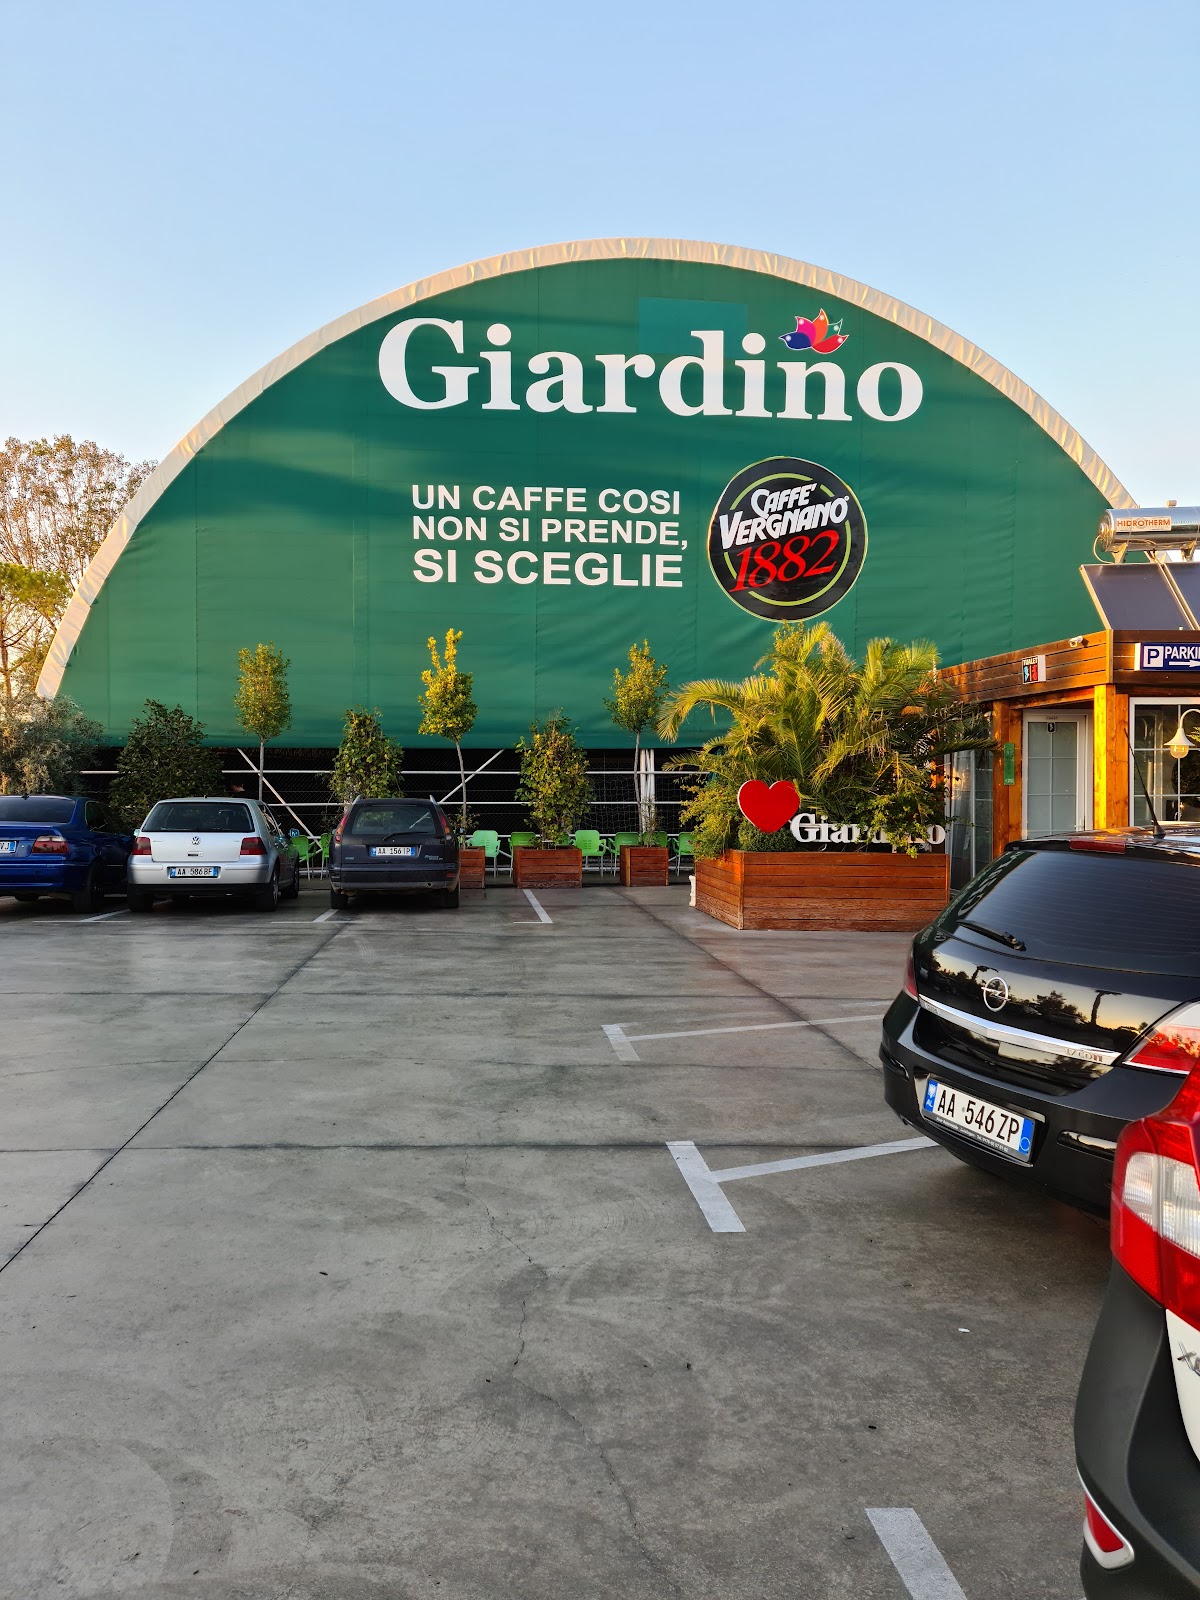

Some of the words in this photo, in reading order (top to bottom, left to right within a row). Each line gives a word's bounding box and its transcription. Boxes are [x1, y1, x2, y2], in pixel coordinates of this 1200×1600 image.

[378, 317, 924, 422] Giardino
[412, 484, 460, 510] UN
[472, 485, 587, 512] CAFFE
[598, 488, 680, 515] COSI
[412, 515, 487, 541] NON
[498, 517, 530, 542] SI
[541, 518, 688, 550] PRENDE,
[719, 496, 848, 549] VERGNANO
[1117, 519, 1170, 527] HIDROTHERM
[412, 548, 457, 583] SI
[473, 550, 683, 588] SCEGLIE
[729, 530, 839, 593] 1882
[1147, 648, 1160, 665] P
[1165, 646, 1200, 659] PARKI
[937, 1089, 956, 1118] AA
